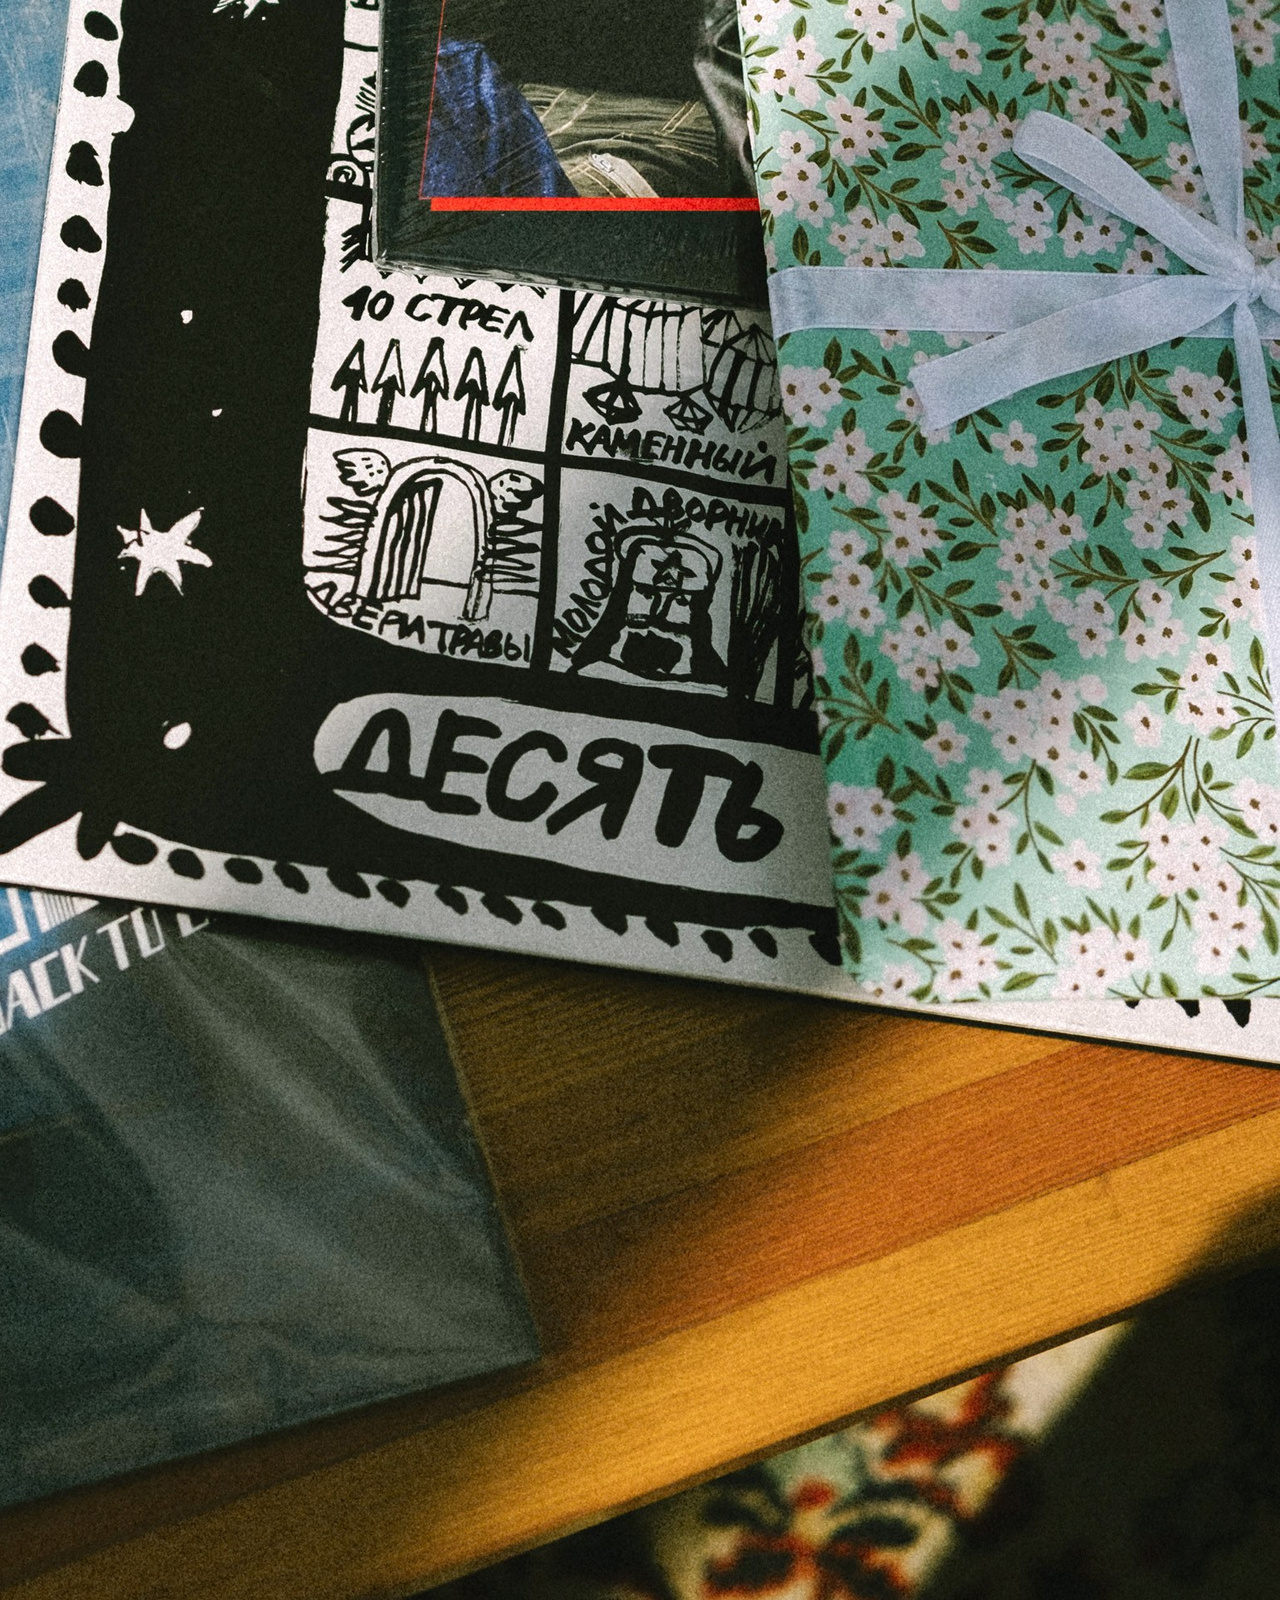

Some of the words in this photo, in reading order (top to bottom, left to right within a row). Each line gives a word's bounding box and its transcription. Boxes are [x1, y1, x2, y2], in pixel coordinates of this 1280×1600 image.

[404, 292, 535, 343] СТРЕЛ
[565, 417, 778, 484] КАМЕННЫЙ
[321, 707, 785, 863] ДЕСЯТЬ
